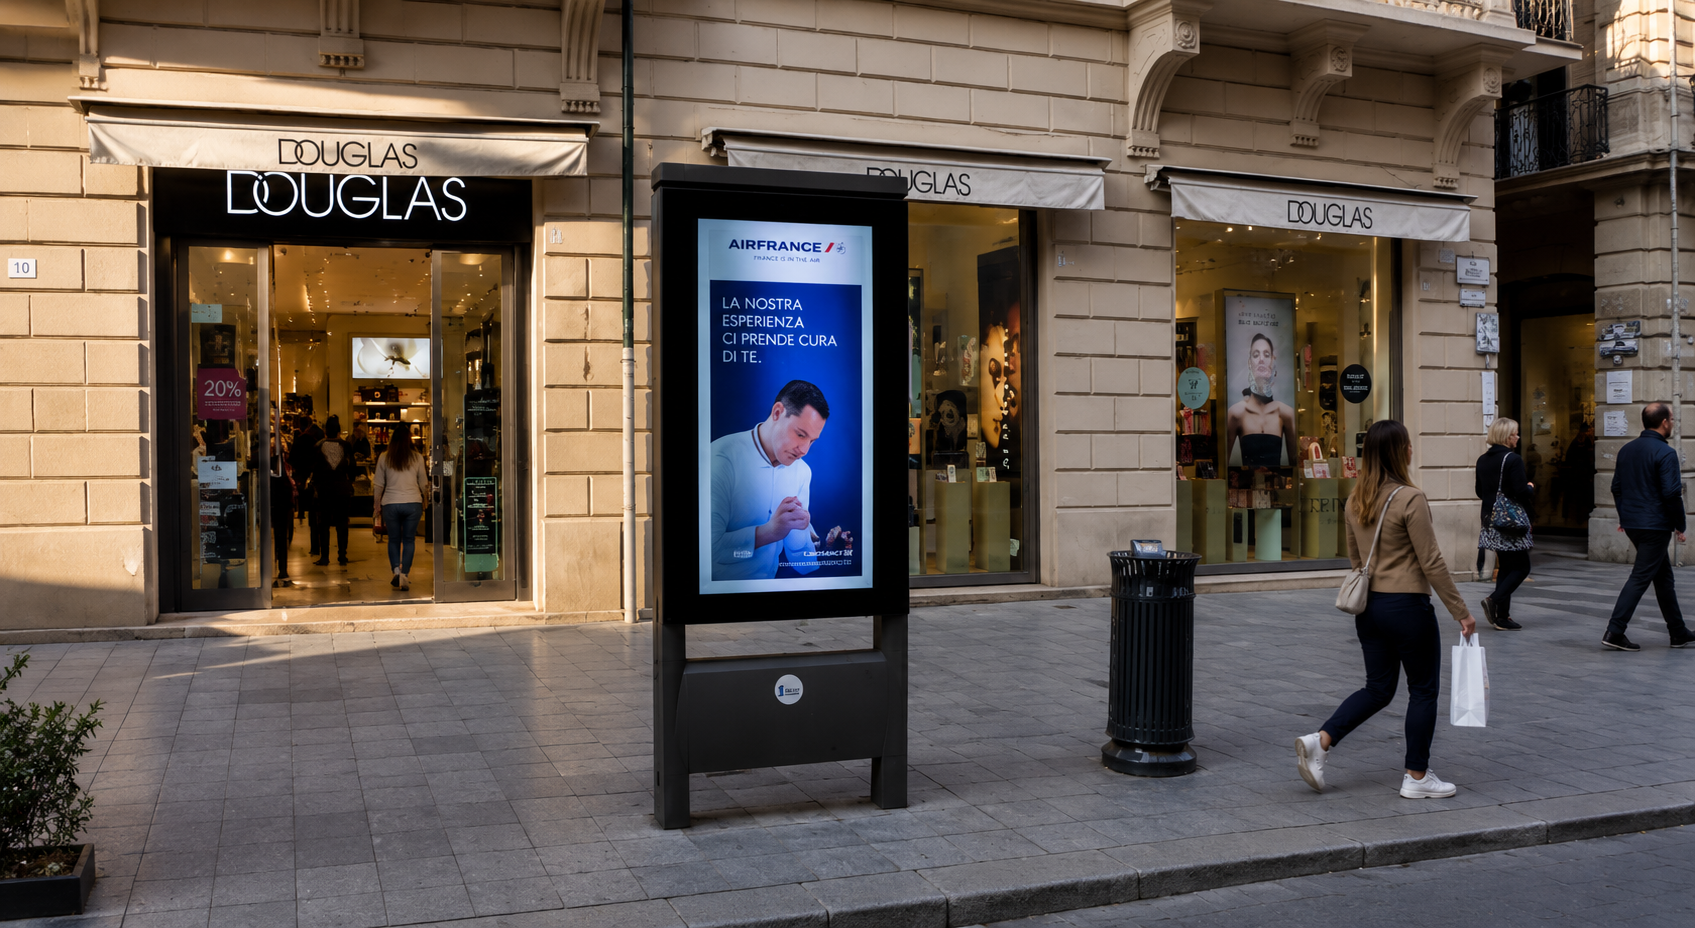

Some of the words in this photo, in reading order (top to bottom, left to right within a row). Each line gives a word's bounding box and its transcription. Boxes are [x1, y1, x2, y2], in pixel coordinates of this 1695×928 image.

[278, 138, 418, 169] DOUGLAS
[226, 170, 467, 221] DOUGLAS
[1287, 200, 1373, 229] DOUGLAS
[728, 239, 822, 253] AIRFRANCE
[14, 262, 30, 274] 10
[722, 297, 741, 309] LA
[745, 297, 803, 311] NOSTRA
[722, 314, 805, 329] ESPERIENZA
[722, 332, 737, 345] CI
[741, 332, 795, 346] PRENDE
[798, 334, 838, 347] CURA
[722, 350, 737, 363] DI
[740, 350, 762, 364] TE.
[204, 380, 242, 397] 20%
